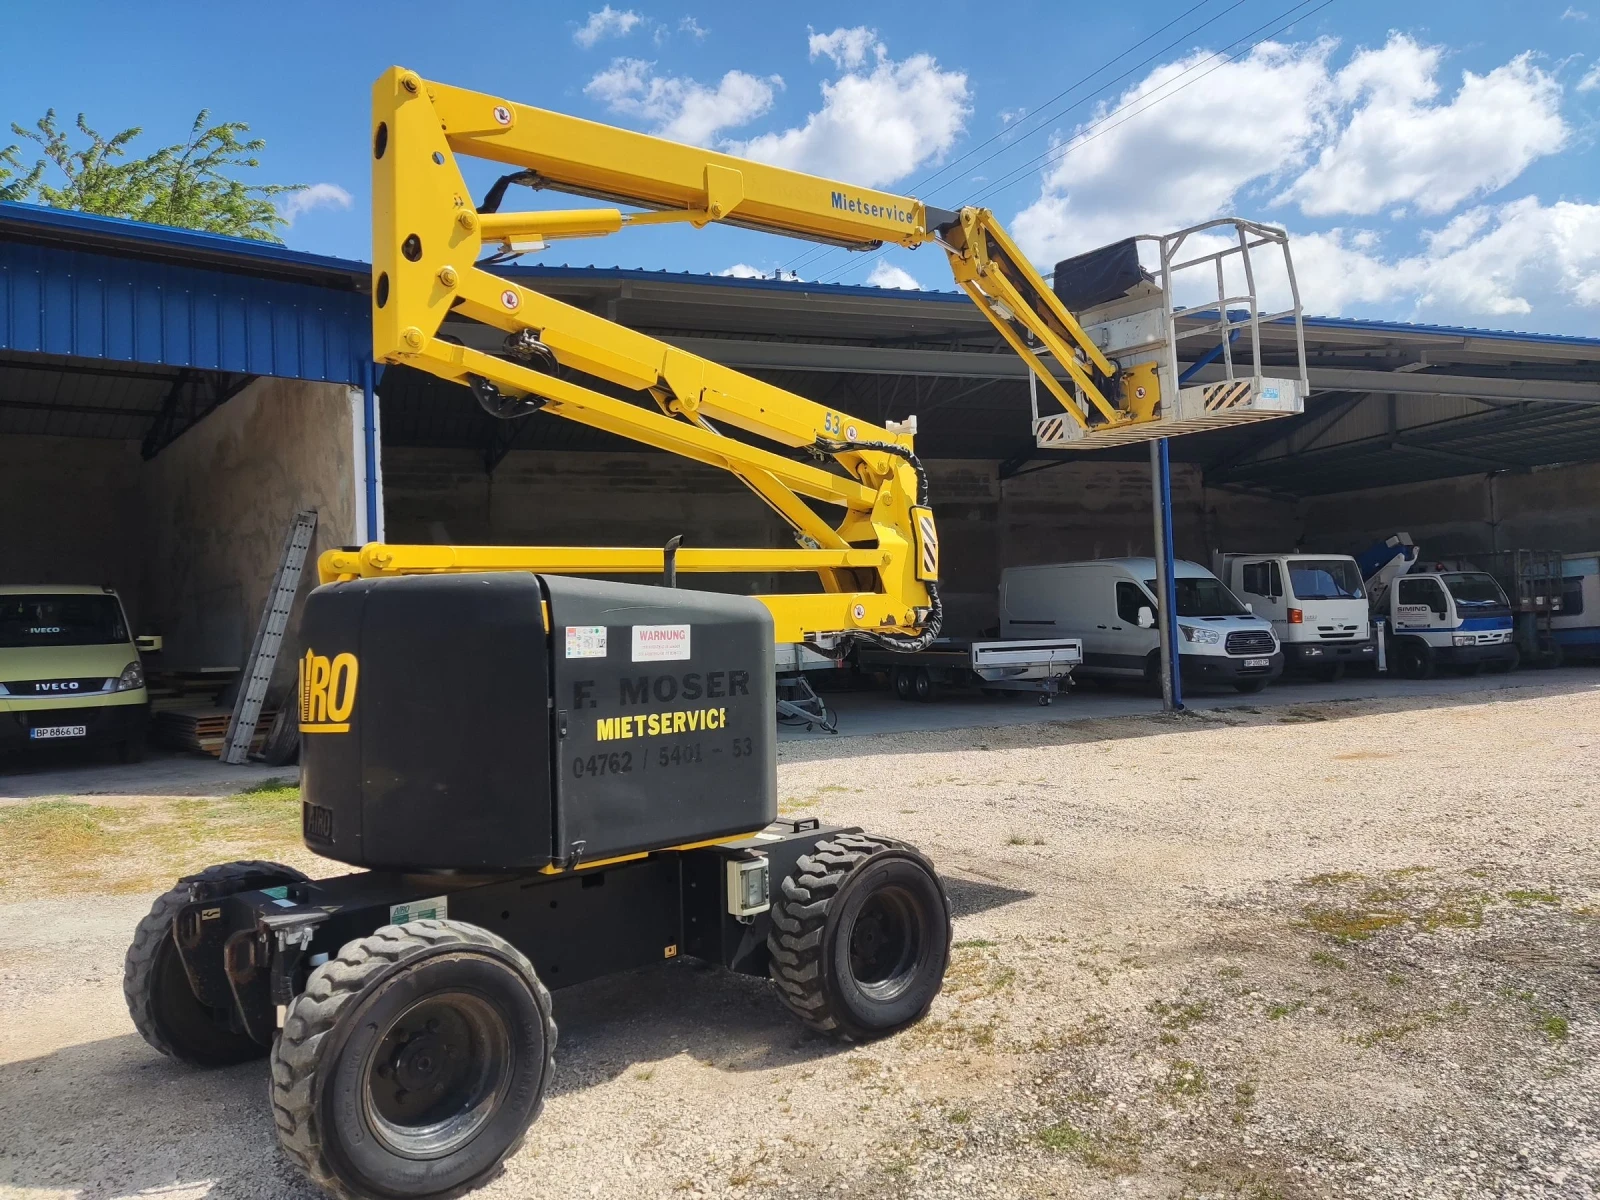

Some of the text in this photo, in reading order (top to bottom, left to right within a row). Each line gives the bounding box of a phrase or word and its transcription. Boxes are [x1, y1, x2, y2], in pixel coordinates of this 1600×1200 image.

[831, 191, 913, 224] Mietservice
[824, 411, 840, 435] 53
[639, 629, 686, 641] WARNUNG
[35, 682, 79, 691] IVECO
[573, 669, 750, 709] F. MOSER
[36, 726, 84, 737] BP 8866 CB
[572, 751, 632, 778] 04762
[731, 737, 753, 758] 53
[307, 806, 330, 837] AIRO
